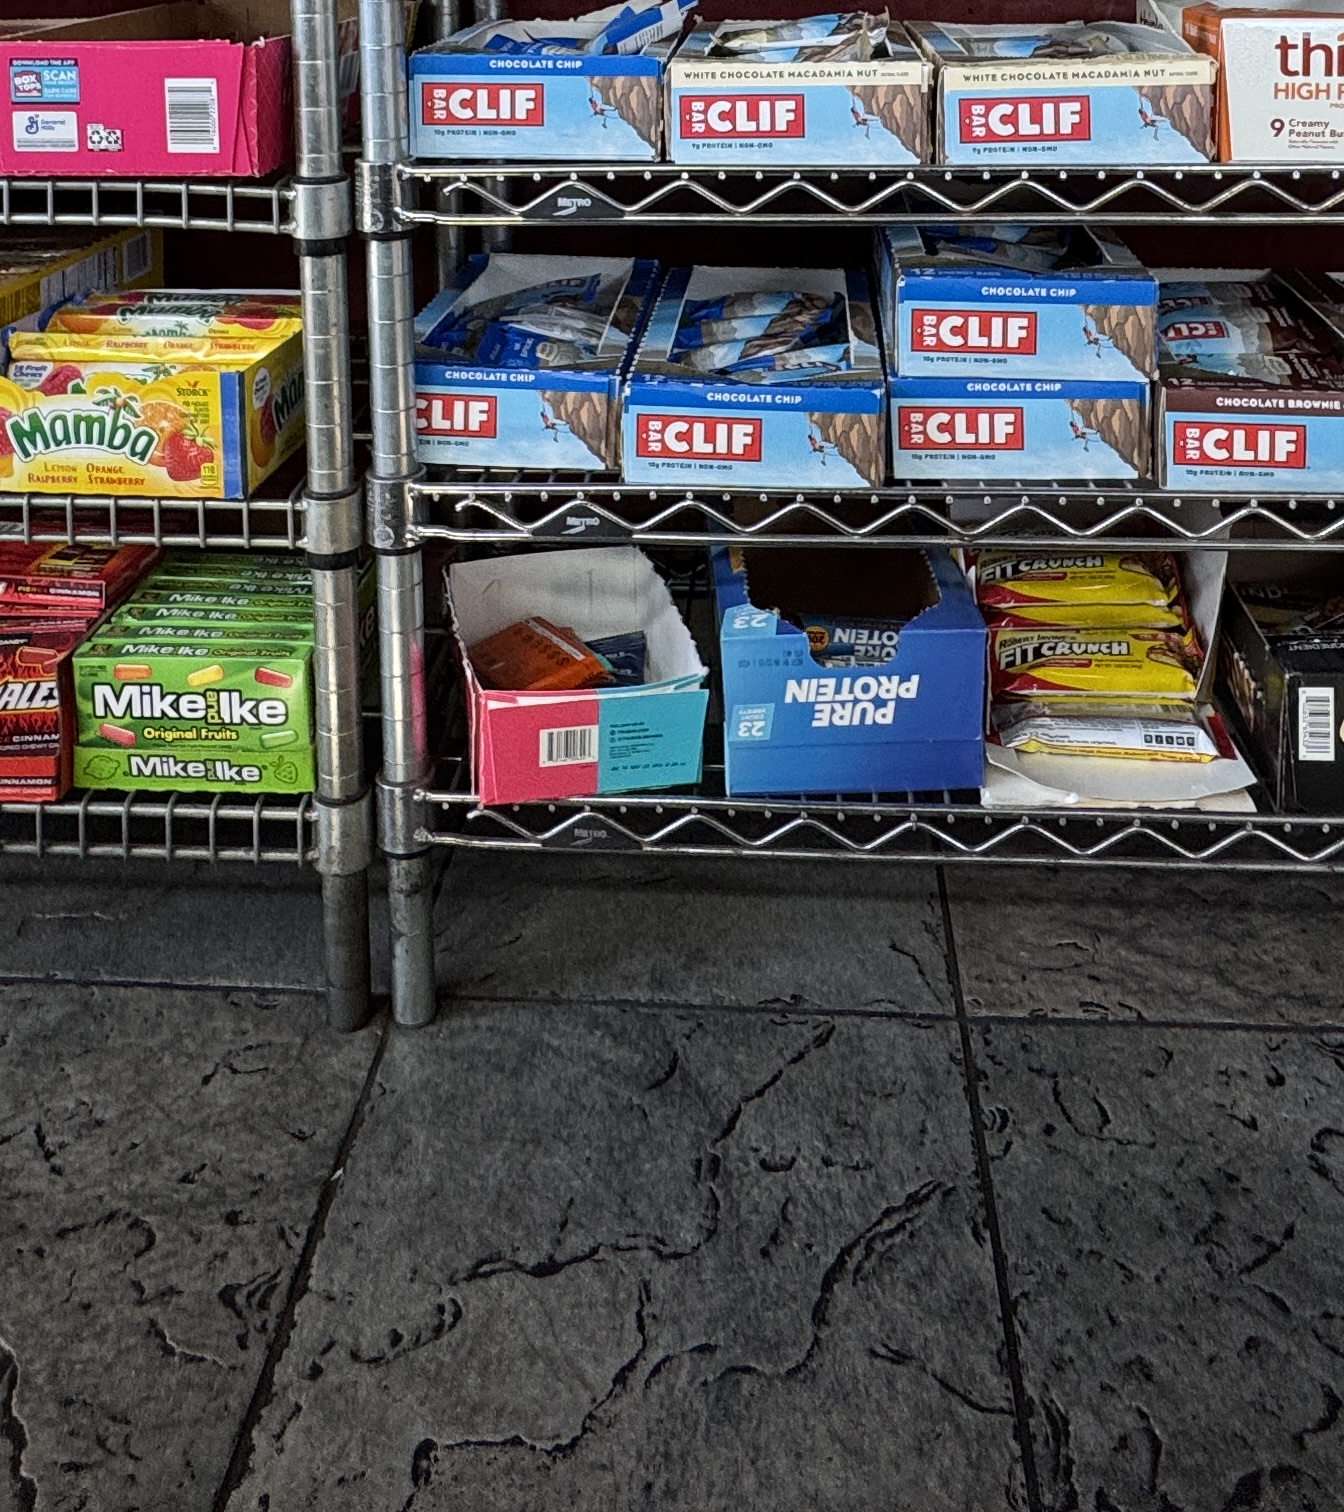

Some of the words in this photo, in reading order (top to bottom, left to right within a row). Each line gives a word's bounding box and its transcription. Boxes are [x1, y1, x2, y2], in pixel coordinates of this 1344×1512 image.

[489, 60, 553, 69] CHOCOLATE
[557, 60, 582, 69] CHIP
[43, 69, 76, 82] SCAN
[684, 71, 716, 80] WHITE
[720, 70, 784, 79] CHOCOLATE
[788, 70, 853, 78] MACADAMIA
[857, 69, 877, 78] NUT
[964, 74, 997, 82] WHITE
[1001, 72, 1068, 81] CHOCOLATE
[1072, 70, 1140, 79] MACADAMIA
[1144, 69, 1165, 78] NUT
[1274, 83, 1330, 100] HIGH
[433, 88, 446, 120] BAR
[449, 89, 536, 120] CLIF
[691, 102, 705, 133] BAR
[707, 100, 796, 132] CLIF
[971, 104, 986, 138] BAR
[988, 102, 1081, 136] CLIF
[1289, 119, 1329, 129] Creamy
[1288, 129, 1325, 138] Peanut
[981, 287, 1046, 296] CHOCOLATE
[1050, 288, 1076, 297] CHIP
[924, 316, 936, 346] BAR
[939, 315, 1028, 348] CLIF
[445, 371, 507, 381] CHOCOLATE
[510, 373, 535, 382] CHIP
[177, 388, 209, 397] STORCK
[967, 383, 1031, 392] CHOCOLATE
[1035, 383, 1061, 392] CHIP
[707, 392, 772, 403] CHOCOLATE
[775, 396, 802, 404] CHIP
[1216, 398, 1284, 409] CHOCOLATE
[1288, 400, 1340, 410] BROWNIE
[8, 410, 156, 462] Mamba
[910, 413, 923, 444] BAR
[926, 413, 1015, 444] CLIF
[648, 421, 662, 452] BAR
[664, 421, 753, 455] CLIF
[1186, 428, 1200, 460] BAR
[1203, 428, 1297, 462] CLIF
[1000, 643, 1041, 670] FIT
[1041, 642, 1128, 655] CRUNCH
[785, 675, 919, 703] PROTEIN
[94, 685, 206, 719] Mike
[220, 691, 287, 724] Ike
[812, 700, 895, 727] PURE
[144, 728, 197, 741] Original
[201, 728, 238, 740] Fruits
[130, 756, 205, 777] Mike
